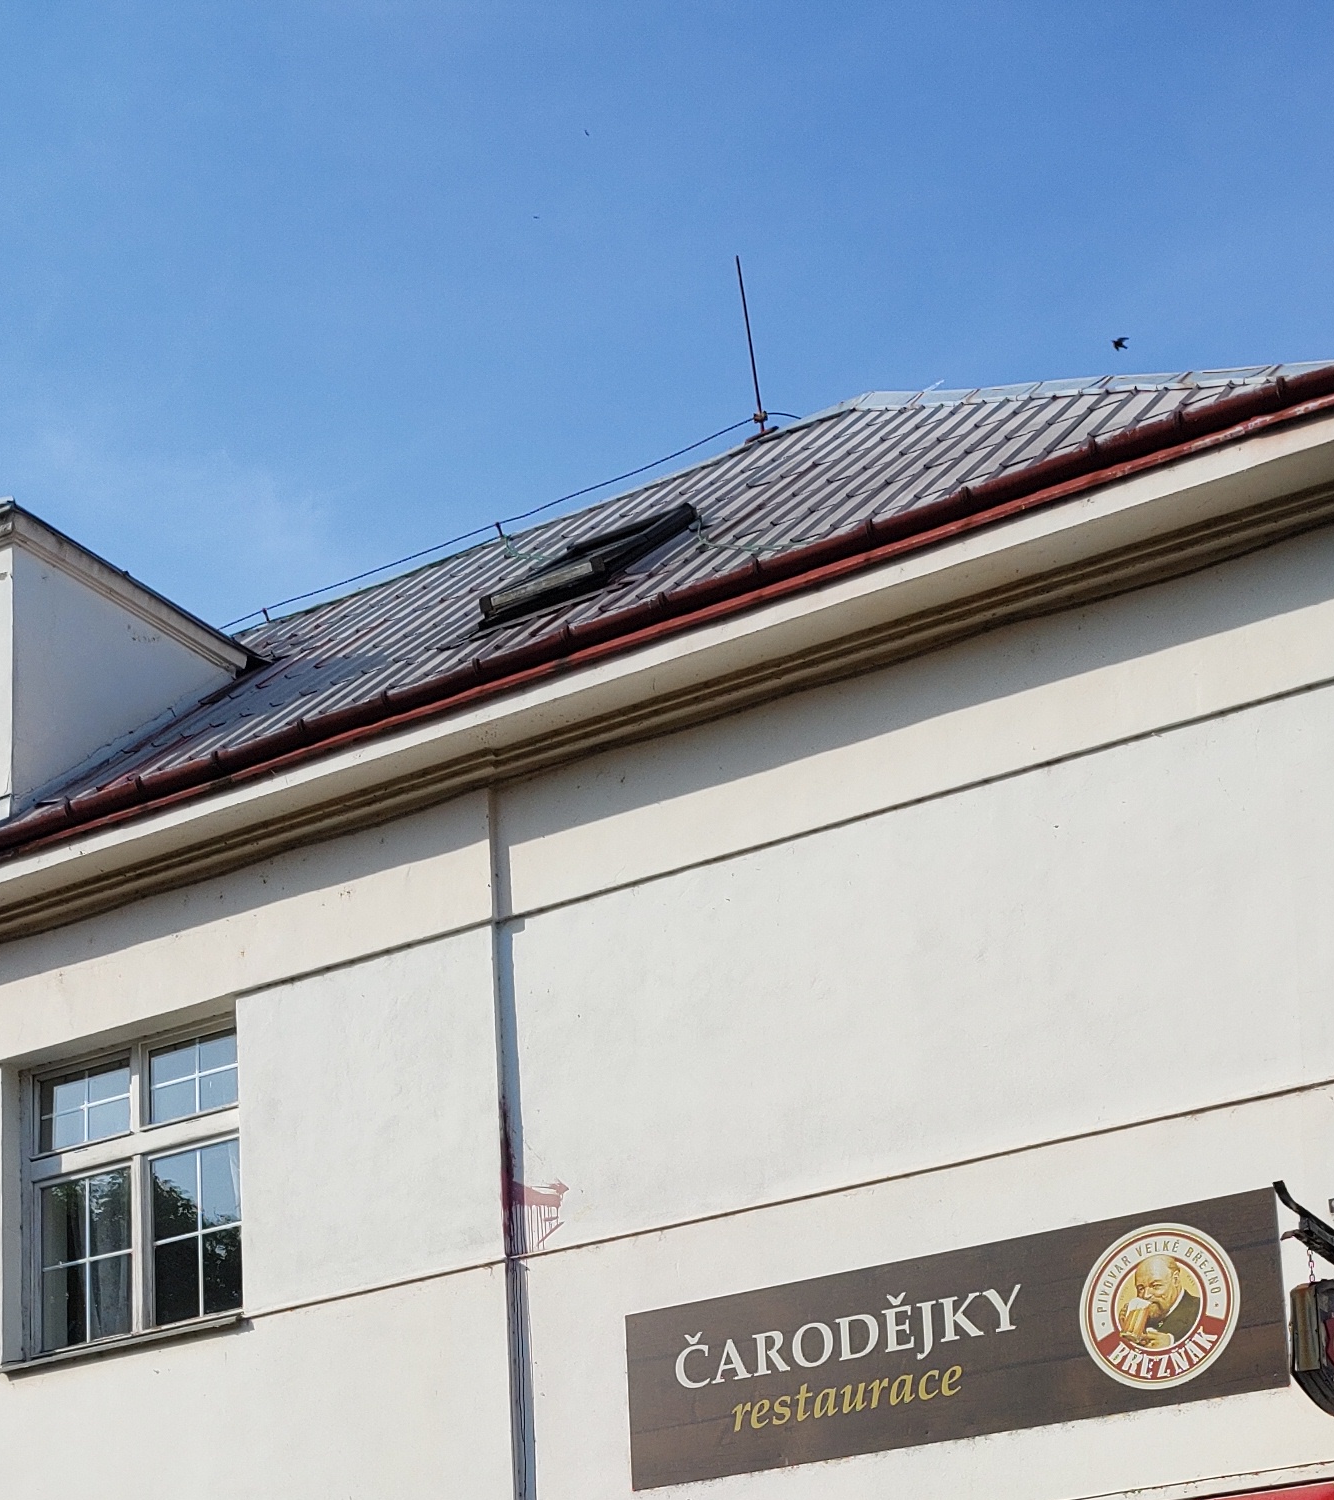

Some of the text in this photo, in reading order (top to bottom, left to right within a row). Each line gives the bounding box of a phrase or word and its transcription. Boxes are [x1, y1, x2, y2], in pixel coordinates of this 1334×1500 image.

[1097, 1239, 1222, 1314] PIVOVAR VELKÉ BŘEZNO
[673, 1282, 1023, 1391] ČARODĚJKY
[1108, 1325, 1218, 1379] BŘEZŇÁK
[730, 1362, 964, 1435] restaurace
